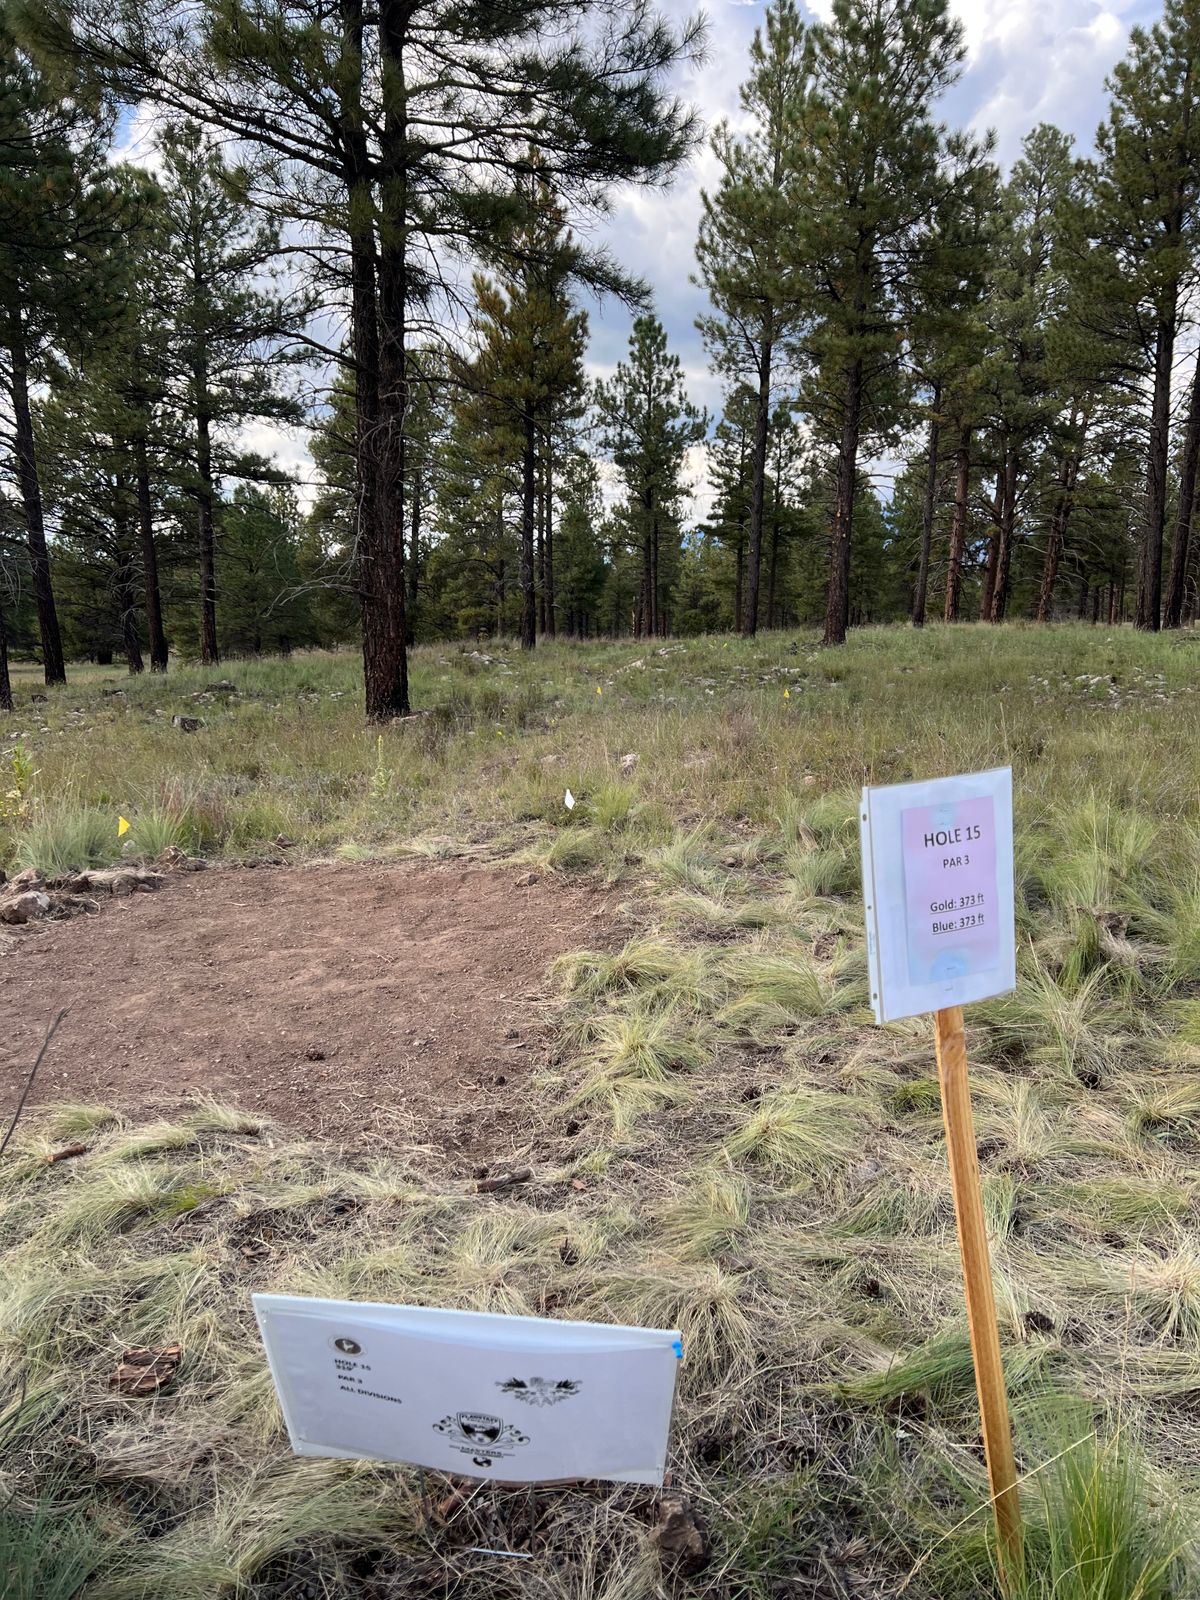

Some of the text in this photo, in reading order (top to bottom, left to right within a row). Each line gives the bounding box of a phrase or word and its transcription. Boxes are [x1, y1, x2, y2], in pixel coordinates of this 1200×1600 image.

[924, 825, 981, 848] HOLE 15
[943, 855, 970, 868] PAR 3
[930, 894, 985, 914] Gold: 373 ft
[932, 913, 985, 934] Blue: 373 ft
[334, 1358, 357, 1368] HOLE
[338, 1374, 355, 1382] PAR
[340, 1385, 402, 1404] ALL DIVISIONS
